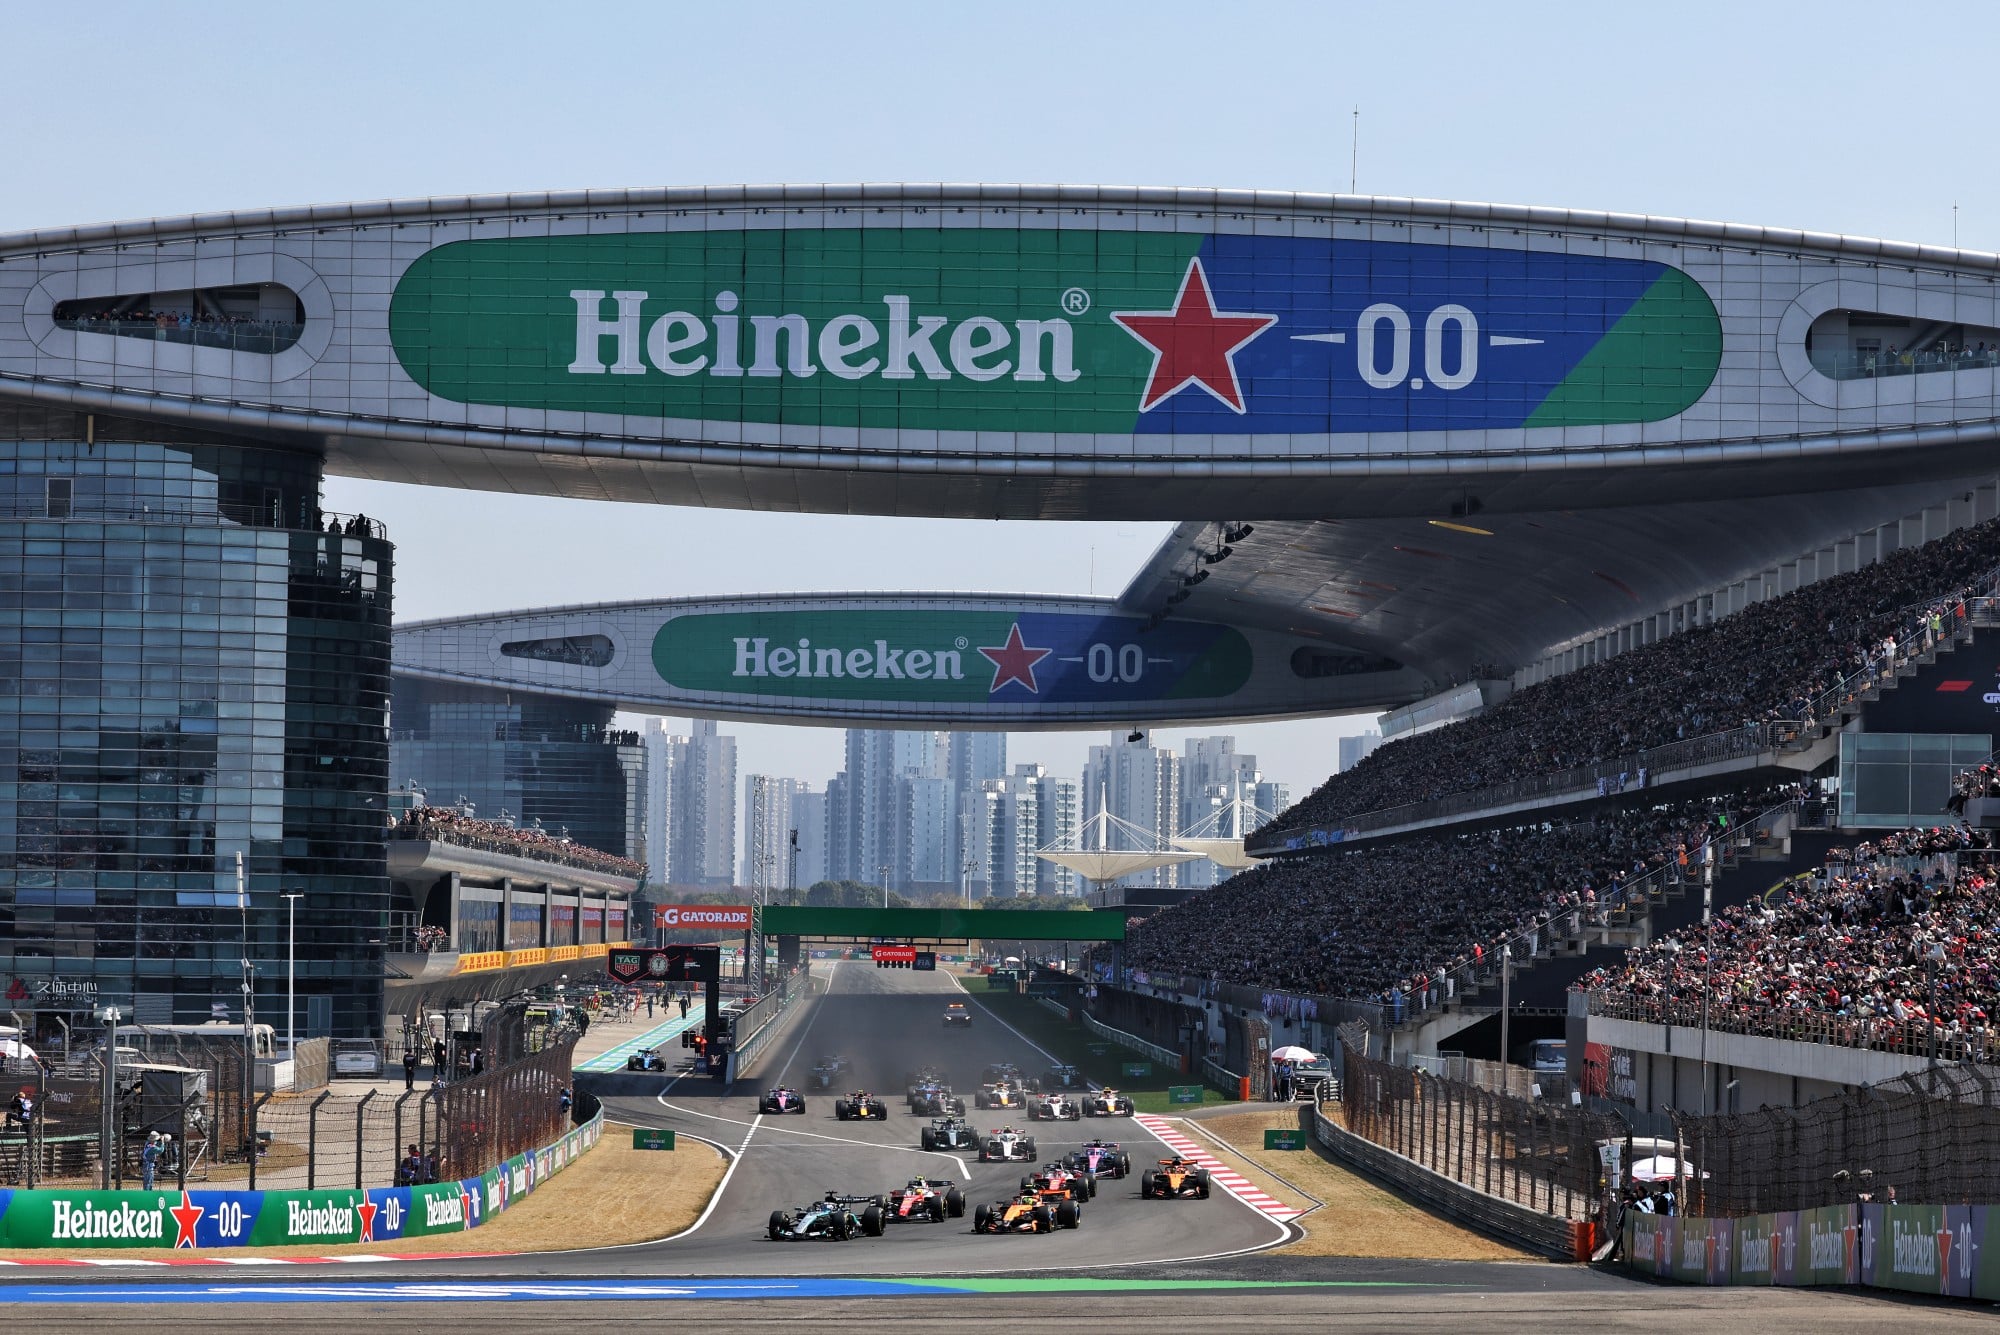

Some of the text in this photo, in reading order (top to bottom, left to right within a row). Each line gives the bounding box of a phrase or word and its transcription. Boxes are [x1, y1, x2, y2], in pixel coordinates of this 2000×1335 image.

[1357, 302, 1479, 390] 0.0
[1087, 643, 1143, 684] 0.0
[681, 911, 748, 923] GATORADE
[617, 956, 638, 964] TAG
[219, 1201, 241, 1238] 0.0
[386, 1197, 400, 1231] 0.0
